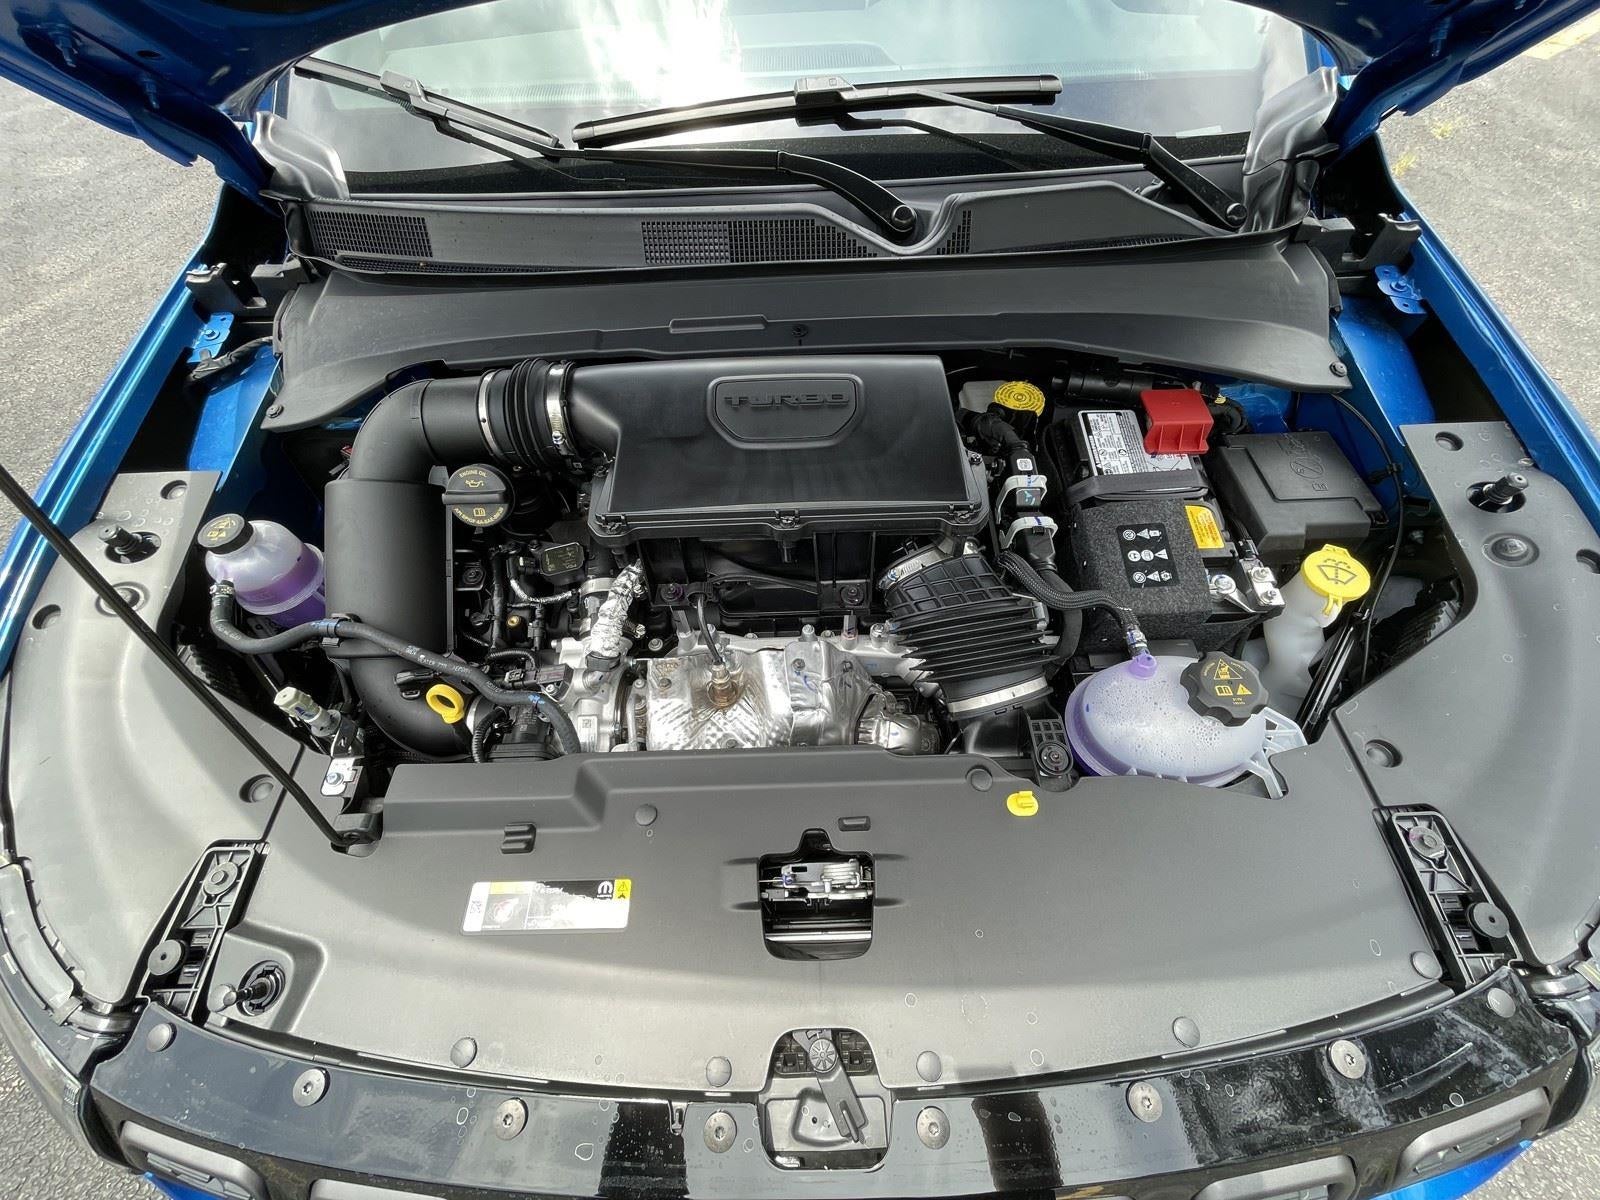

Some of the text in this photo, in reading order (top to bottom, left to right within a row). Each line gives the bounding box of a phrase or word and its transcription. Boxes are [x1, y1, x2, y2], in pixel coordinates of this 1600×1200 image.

[723, 393, 850, 409] TURBO
[459, 469, 488, 478] ENGINE OIL
